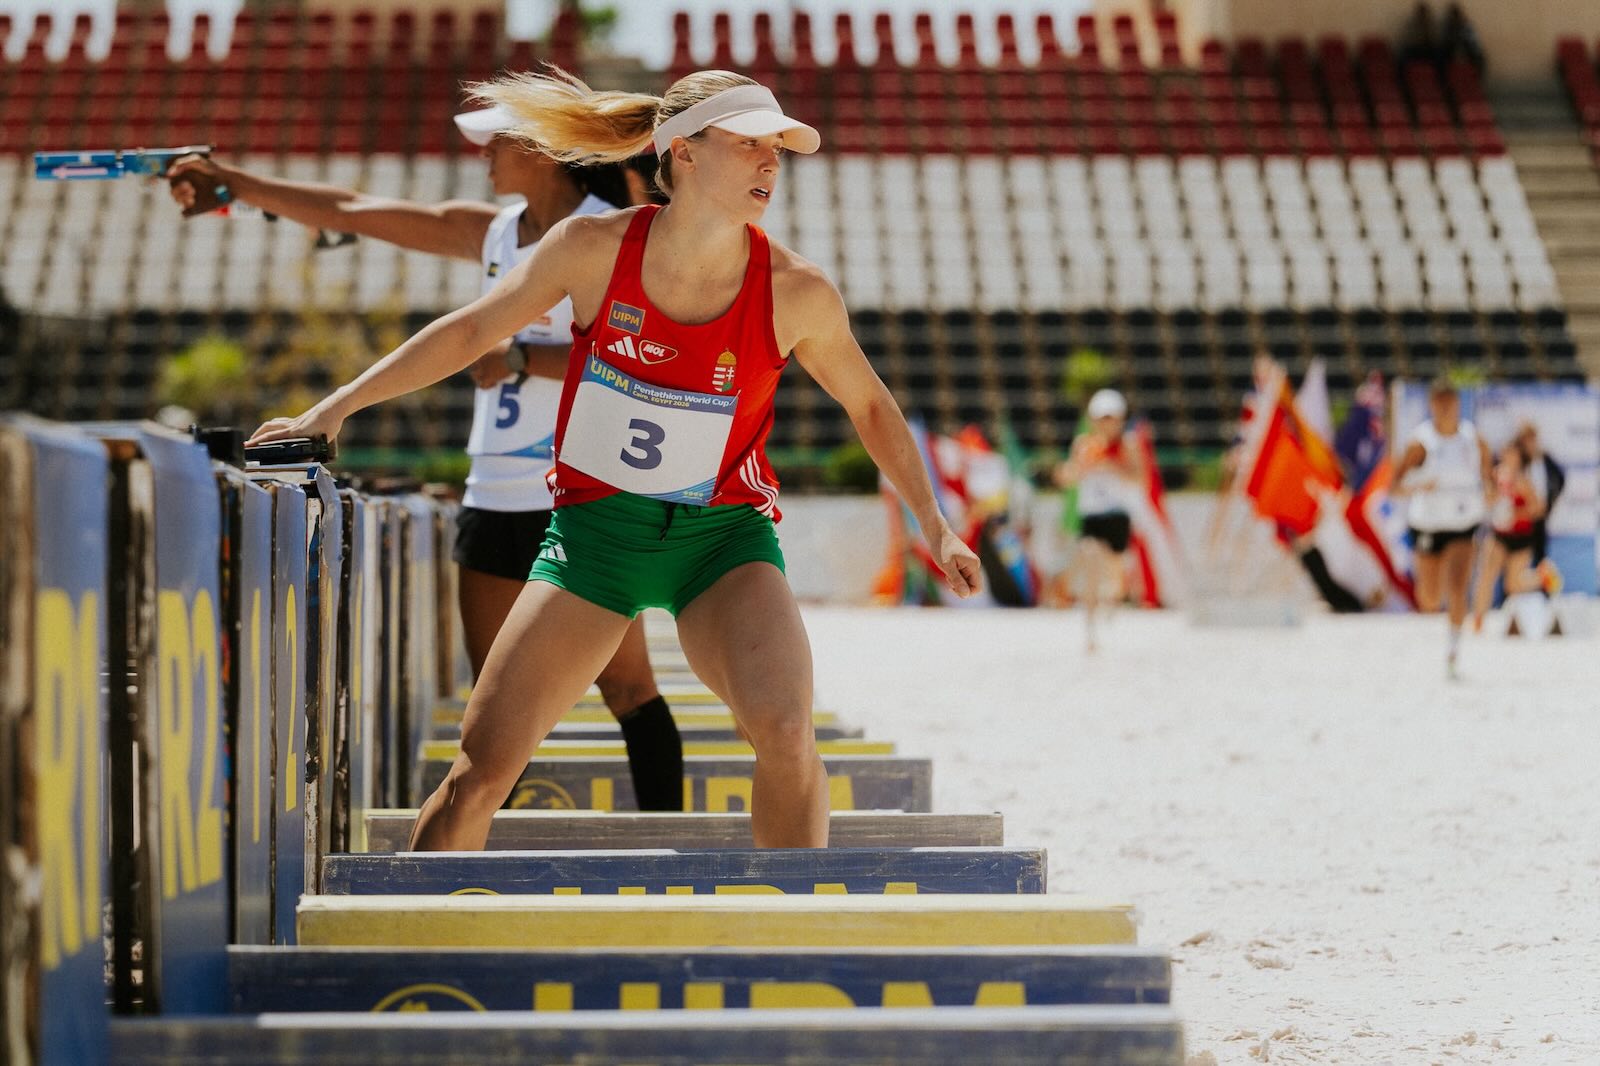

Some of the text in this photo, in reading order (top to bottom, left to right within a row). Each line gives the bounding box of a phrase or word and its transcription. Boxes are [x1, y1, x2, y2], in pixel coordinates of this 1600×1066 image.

[612, 310, 640, 327] UIPM
[643, 343, 666, 358] MOL
[590, 360, 630, 392] UIPM
[633, 383, 730, 408] Pentathlon World Cup
[495, 383, 521, 430] 5
[651, 396, 672, 406] EGYPT
[619, 418, 666, 470] 3
[251, 588, 261, 843] 1
[285, 583, 297, 812] 2
[158, 587, 222, 899] R2
[38, 587, 100, 968] R1
